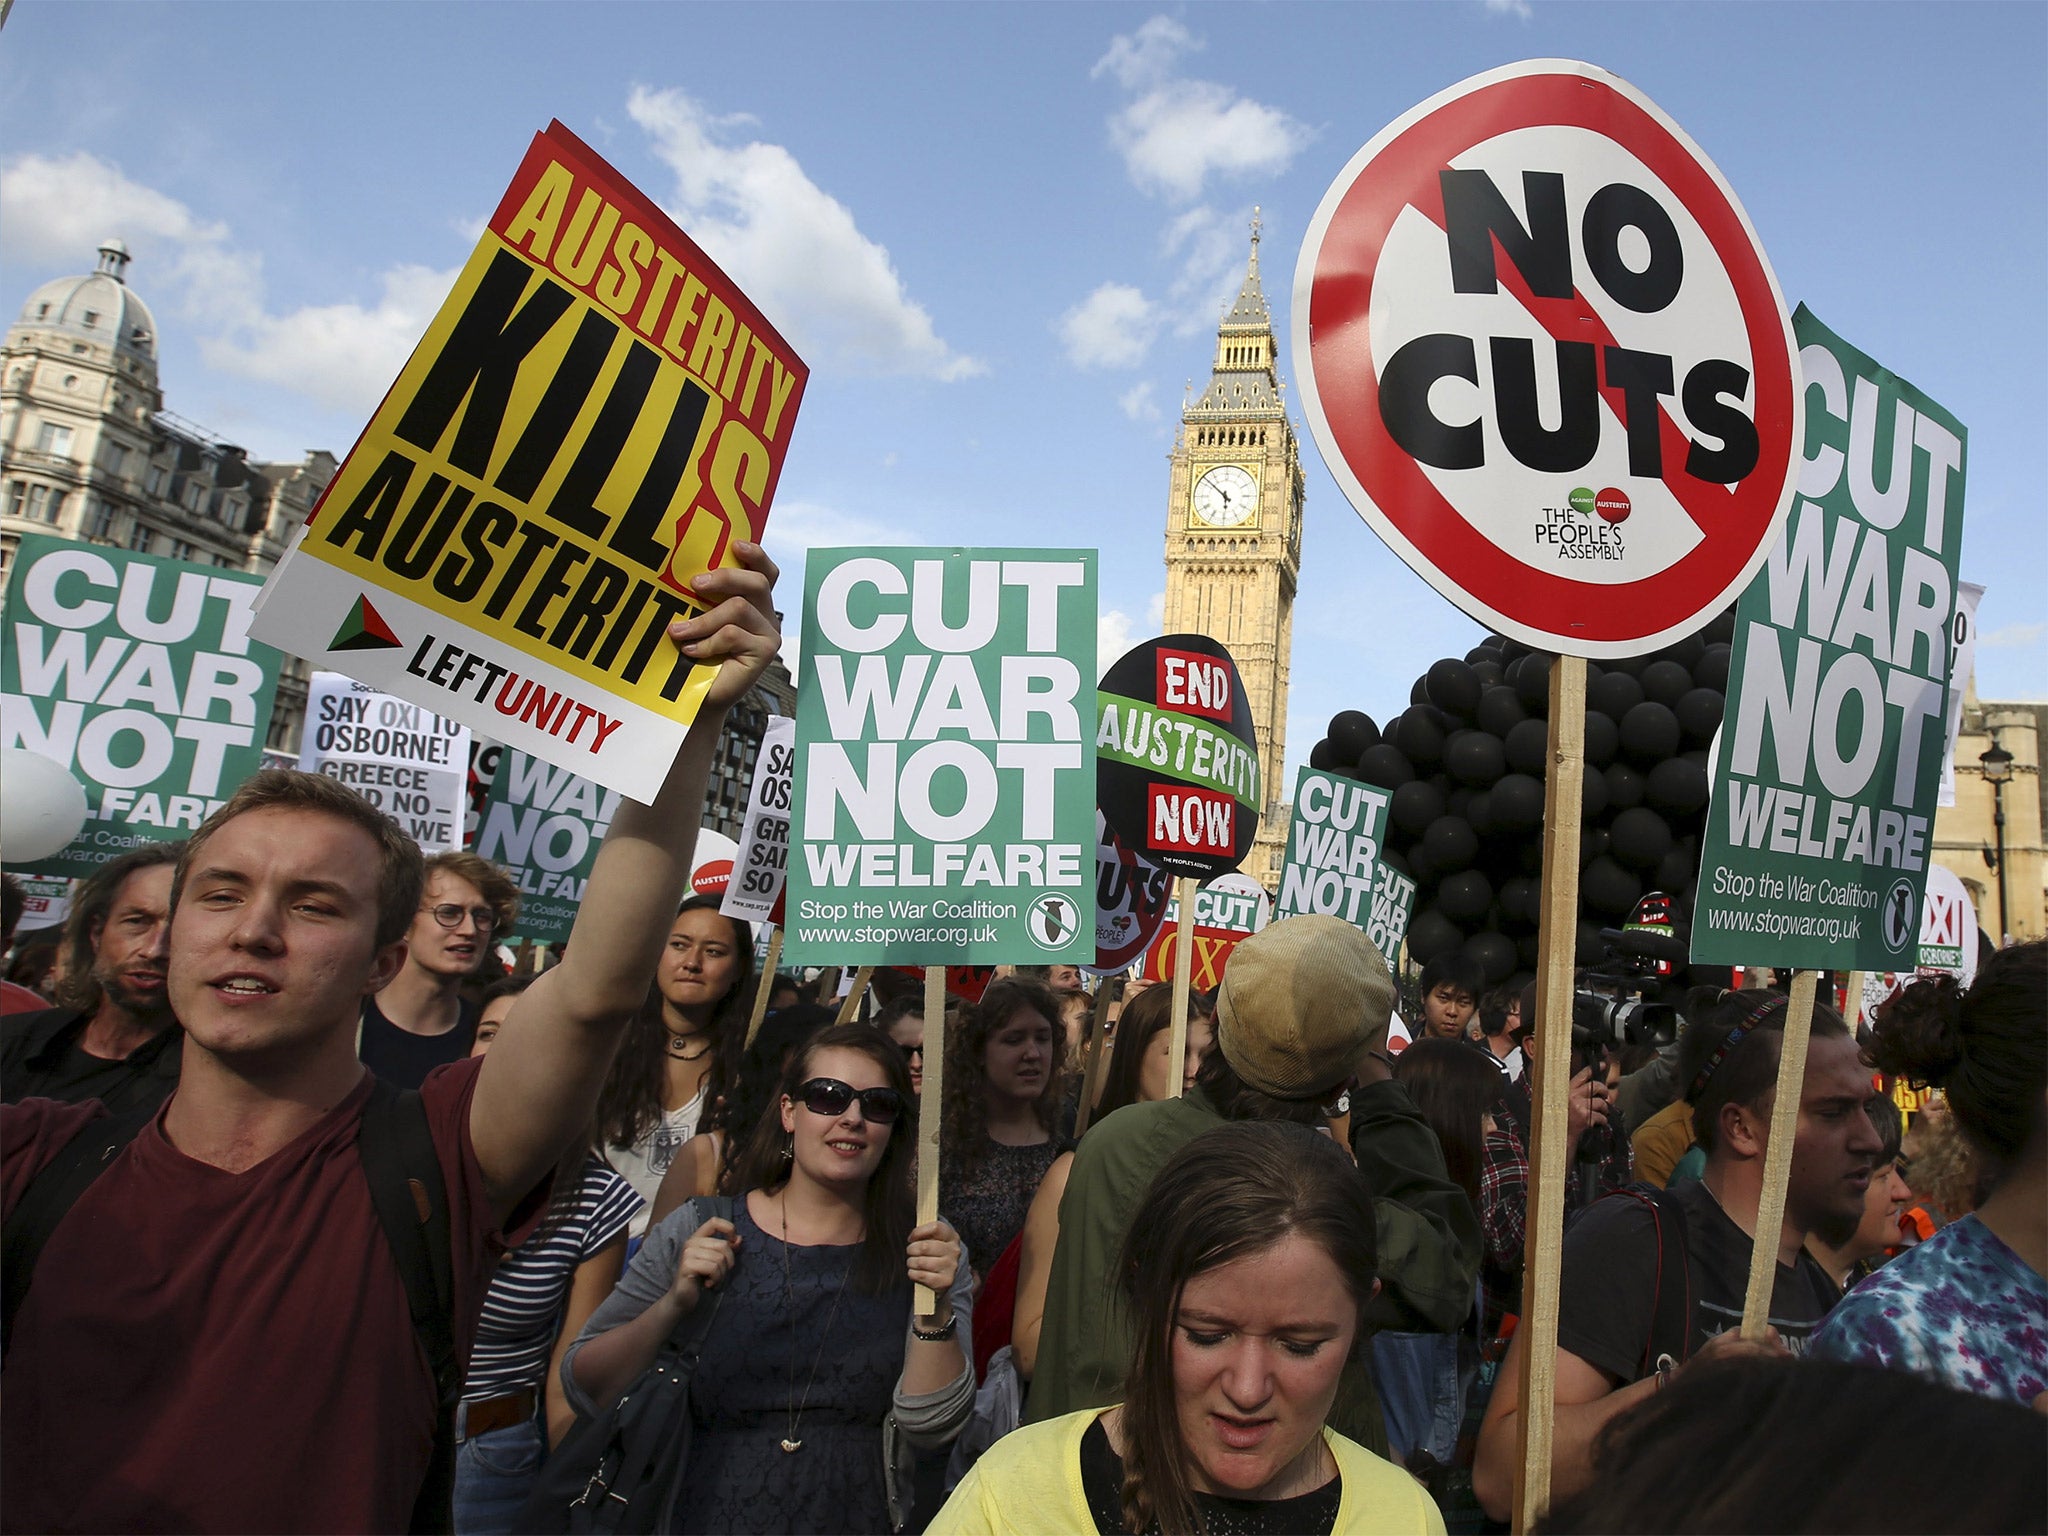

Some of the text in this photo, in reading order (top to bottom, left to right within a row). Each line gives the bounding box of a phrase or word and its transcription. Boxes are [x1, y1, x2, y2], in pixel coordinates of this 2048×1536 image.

[1439, 169, 1683, 313] NO
[504, 159, 796, 442] AUSTERITY
[393, 247, 770, 588] KILLS
[1378, 333, 1759, 485] CUTS
[1795, 344, 1962, 556] CUT
[1542, 508, 1575, 523] THE
[1596, 501, 1630, 510] AUSTERITY
[1558, 544, 1625, 561] ASSEMBLY
[23, 549, 252, 656] CUT
[817, 558, 1084, 653] CUT
[1766, 500, 1951, 678] WAR
[15, 621, 264, 727] WAR
[814, 655, 1082, 741] WAR
[1164, 657, 1229, 711] END
[319, 694, 371, 723] SAY
[379, 700, 420, 731] OXI
[1730, 620, 1943, 808] NOT
[316, 724, 450, 765] OSBORNE!
[1096, 704, 1257, 802] AUSTERITY
[319, 761, 429, 791] GREECE
[392, 791, 431, 816] NO
[803, 740, 1082, 842] NOT
[409, 818, 452, 843] WE
[1154, 795, 1231, 848] NOW
[1300, 775, 1388, 837] CUT
[1728, 779, 1928, 872] WELFARE
[477, 801, 611, 873] NO
[1295, 820, 1377, 879] WAR
[694, 874, 731, 887] AUSTER
[742, 869, 774, 894] SO
[803, 844, 1082, 887] WELFARE
[1095, 861, 1169, 916] UTS
[1279, 862, 1371, 923] NOT
[1713, 866, 1878, 909] Stop the War Coalition
[799, 923, 998, 947] www.stopwar.org.uk
[800, 900, 1017, 924] Stop the War Coalition
[1194, 891, 1255, 926] CUT
[1708, 908, 1862, 944] www.stopwar.org.uk
